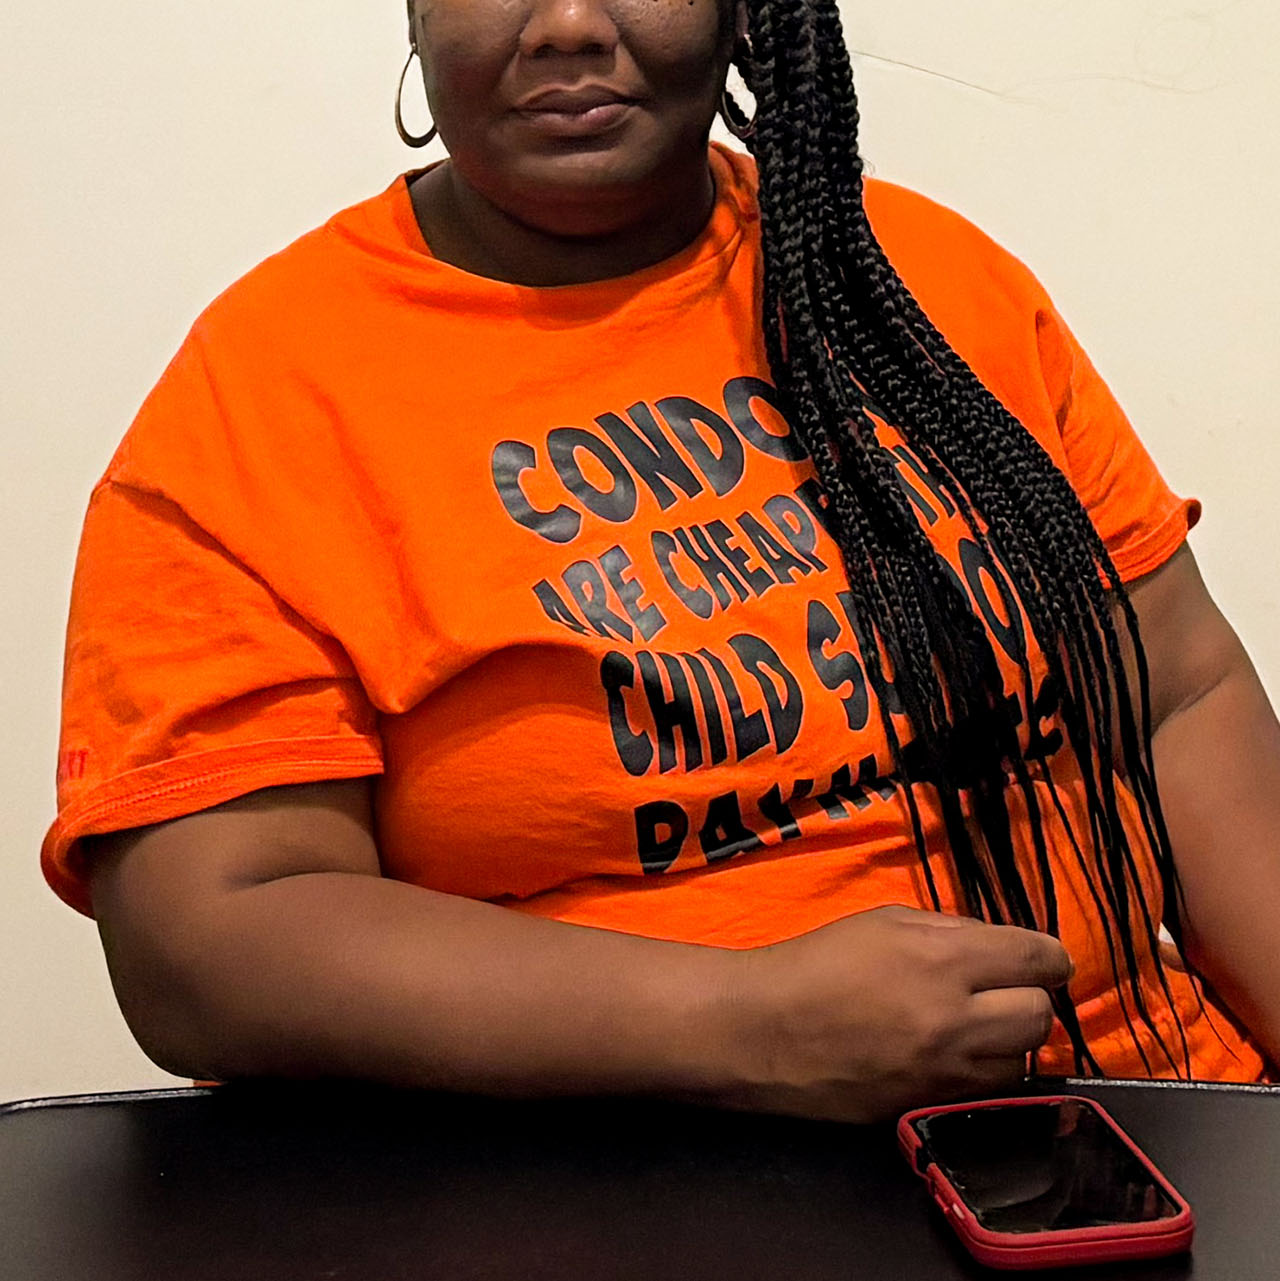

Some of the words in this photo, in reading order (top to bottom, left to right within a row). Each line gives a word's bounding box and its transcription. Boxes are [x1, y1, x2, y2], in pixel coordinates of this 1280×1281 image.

[491, 375, 815, 545] CONDO
[531, 545, 667, 644] ARE
[650, 478, 830, 620] CHEAP
[600, 633, 804, 777] CHILD
